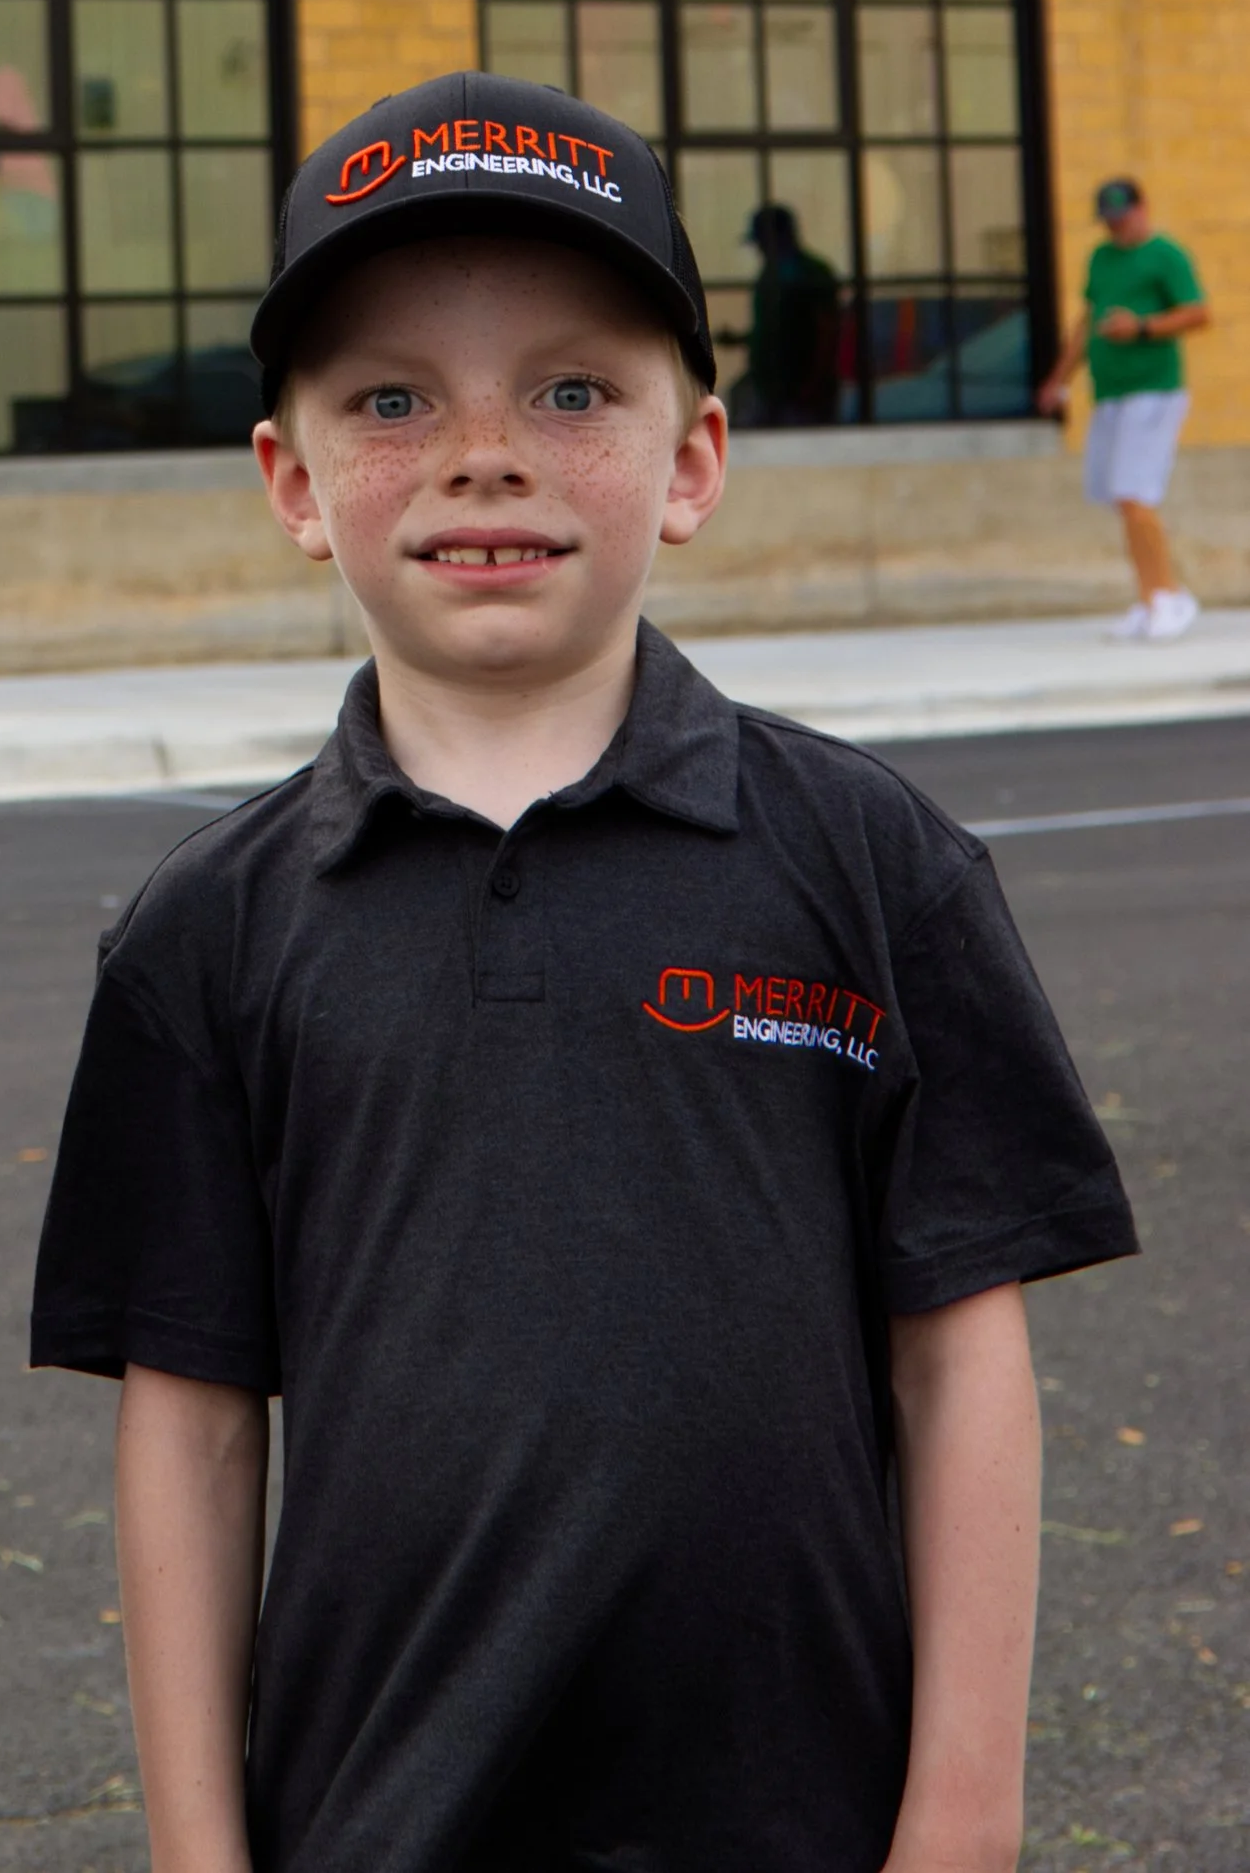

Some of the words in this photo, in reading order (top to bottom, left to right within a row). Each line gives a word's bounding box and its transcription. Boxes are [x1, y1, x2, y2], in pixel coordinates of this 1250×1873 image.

[412, 119, 614, 178] MERRITT
[411, 152, 580, 190] ENGINEERING,
[582, 171, 622, 203] LLC
[733, 973, 886, 1044] MERRITT
[733, 1014, 842, 1055] ENGINEERING,
[846, 1036, 879, 1070] LLC
